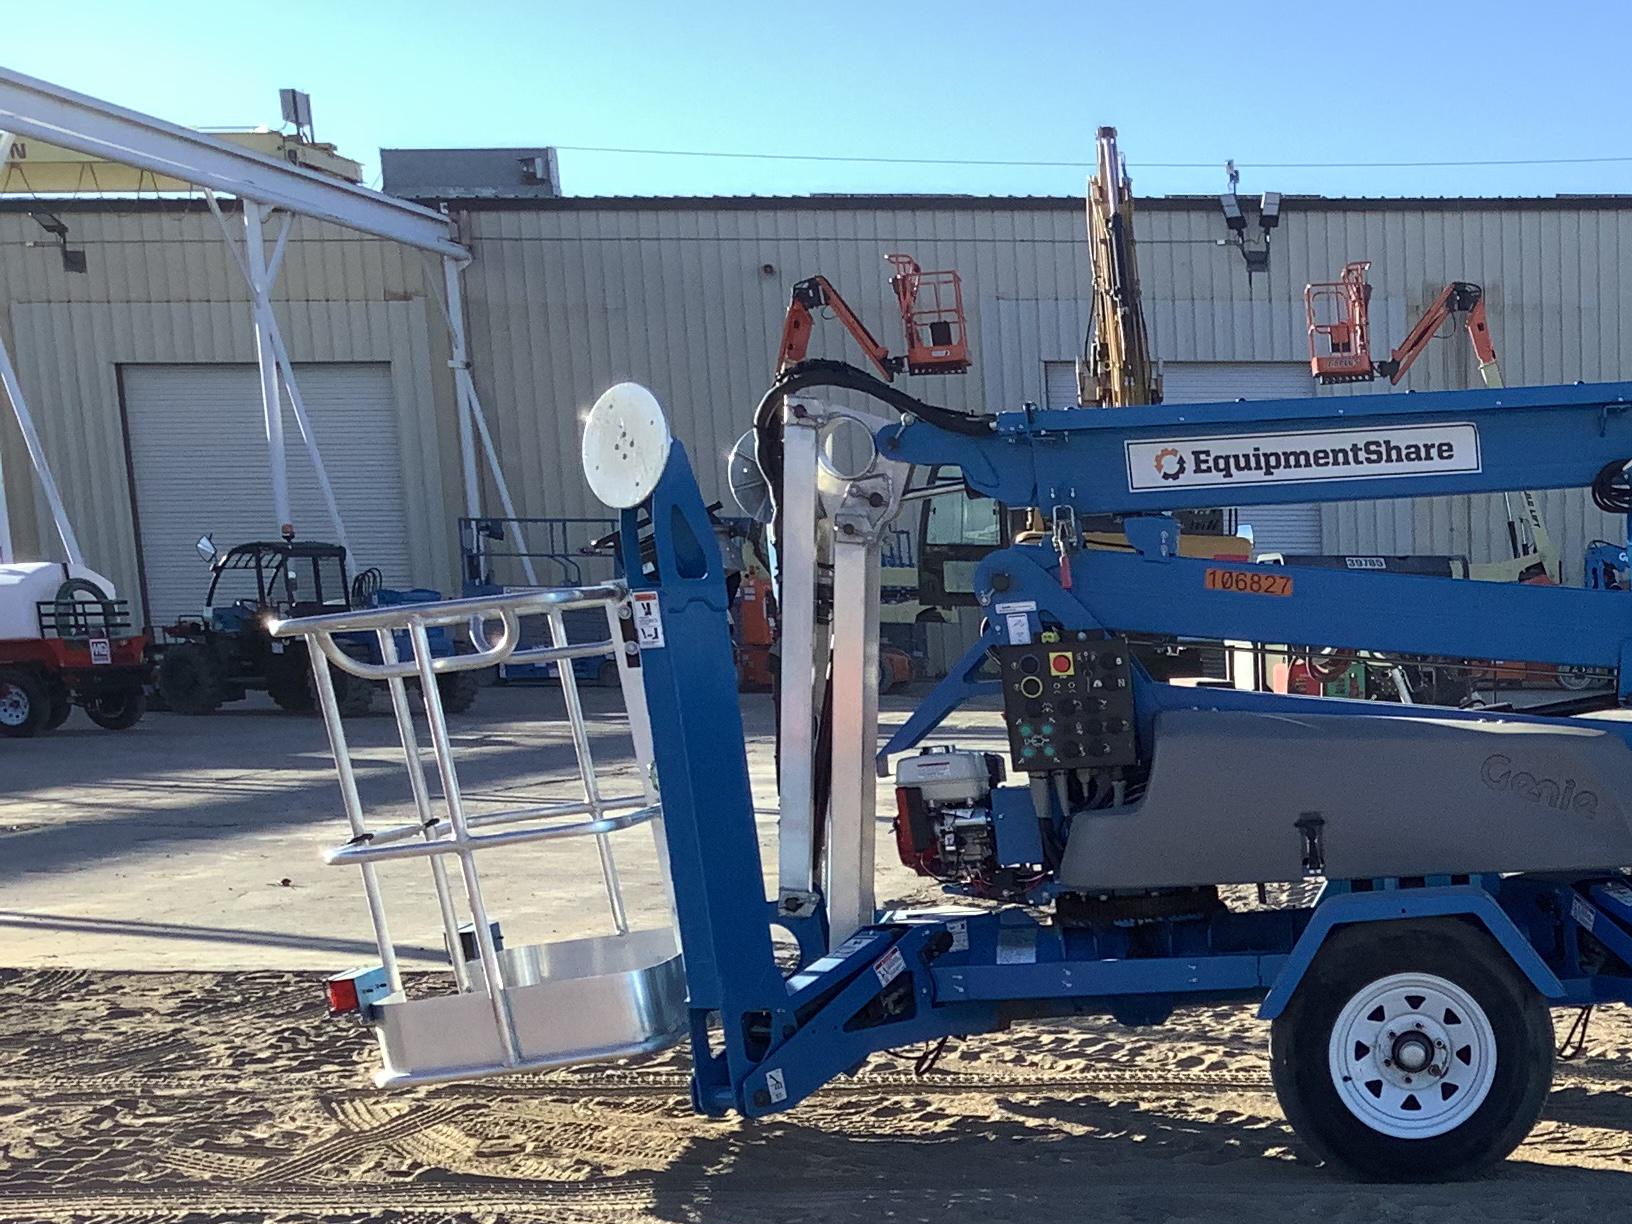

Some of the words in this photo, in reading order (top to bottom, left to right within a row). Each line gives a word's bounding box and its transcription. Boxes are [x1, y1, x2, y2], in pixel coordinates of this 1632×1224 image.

[1191, 440, 1455, 478] EquipmentShare
[1207, 570, 1290, 594] 106827
[1480, 753, 1599, 820] Genie
